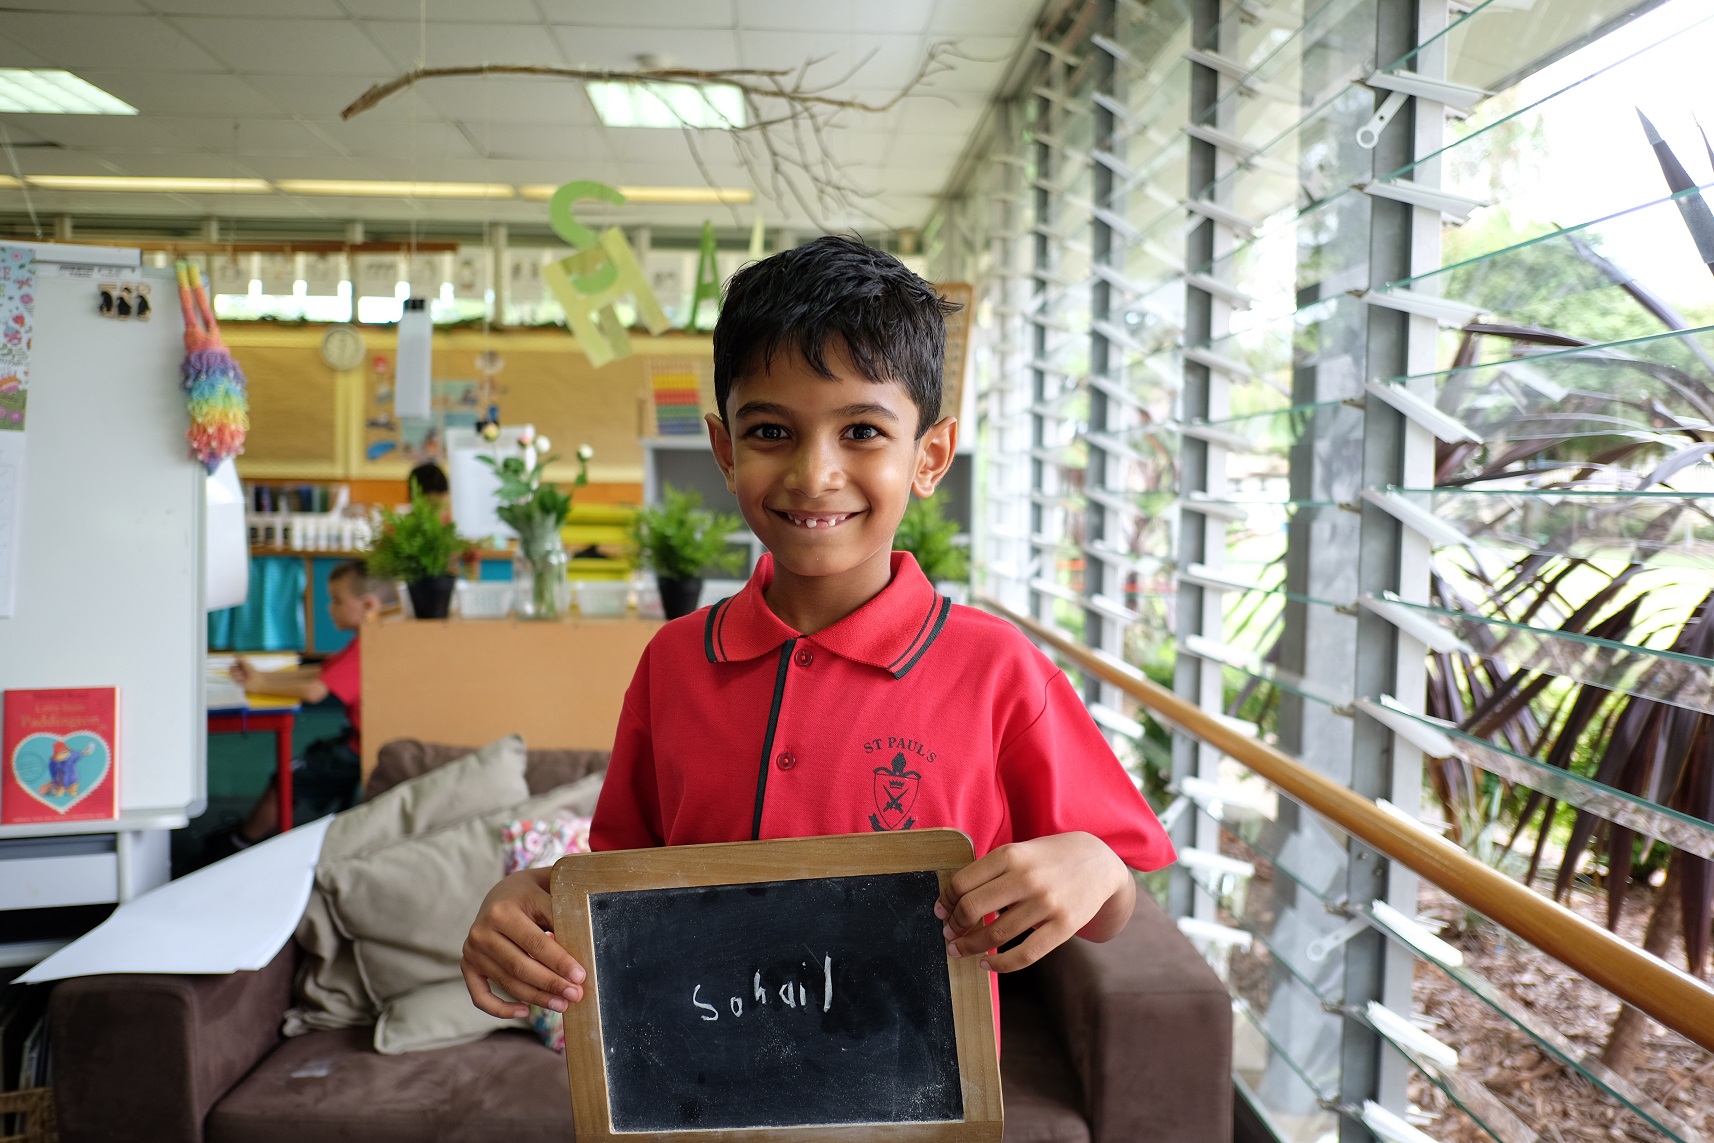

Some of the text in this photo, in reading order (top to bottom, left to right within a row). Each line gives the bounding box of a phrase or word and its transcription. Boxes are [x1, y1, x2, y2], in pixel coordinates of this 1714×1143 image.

[863, 736, 937, 763] ST PAUL'S
[692, 951, 833, 1021] Sohail
